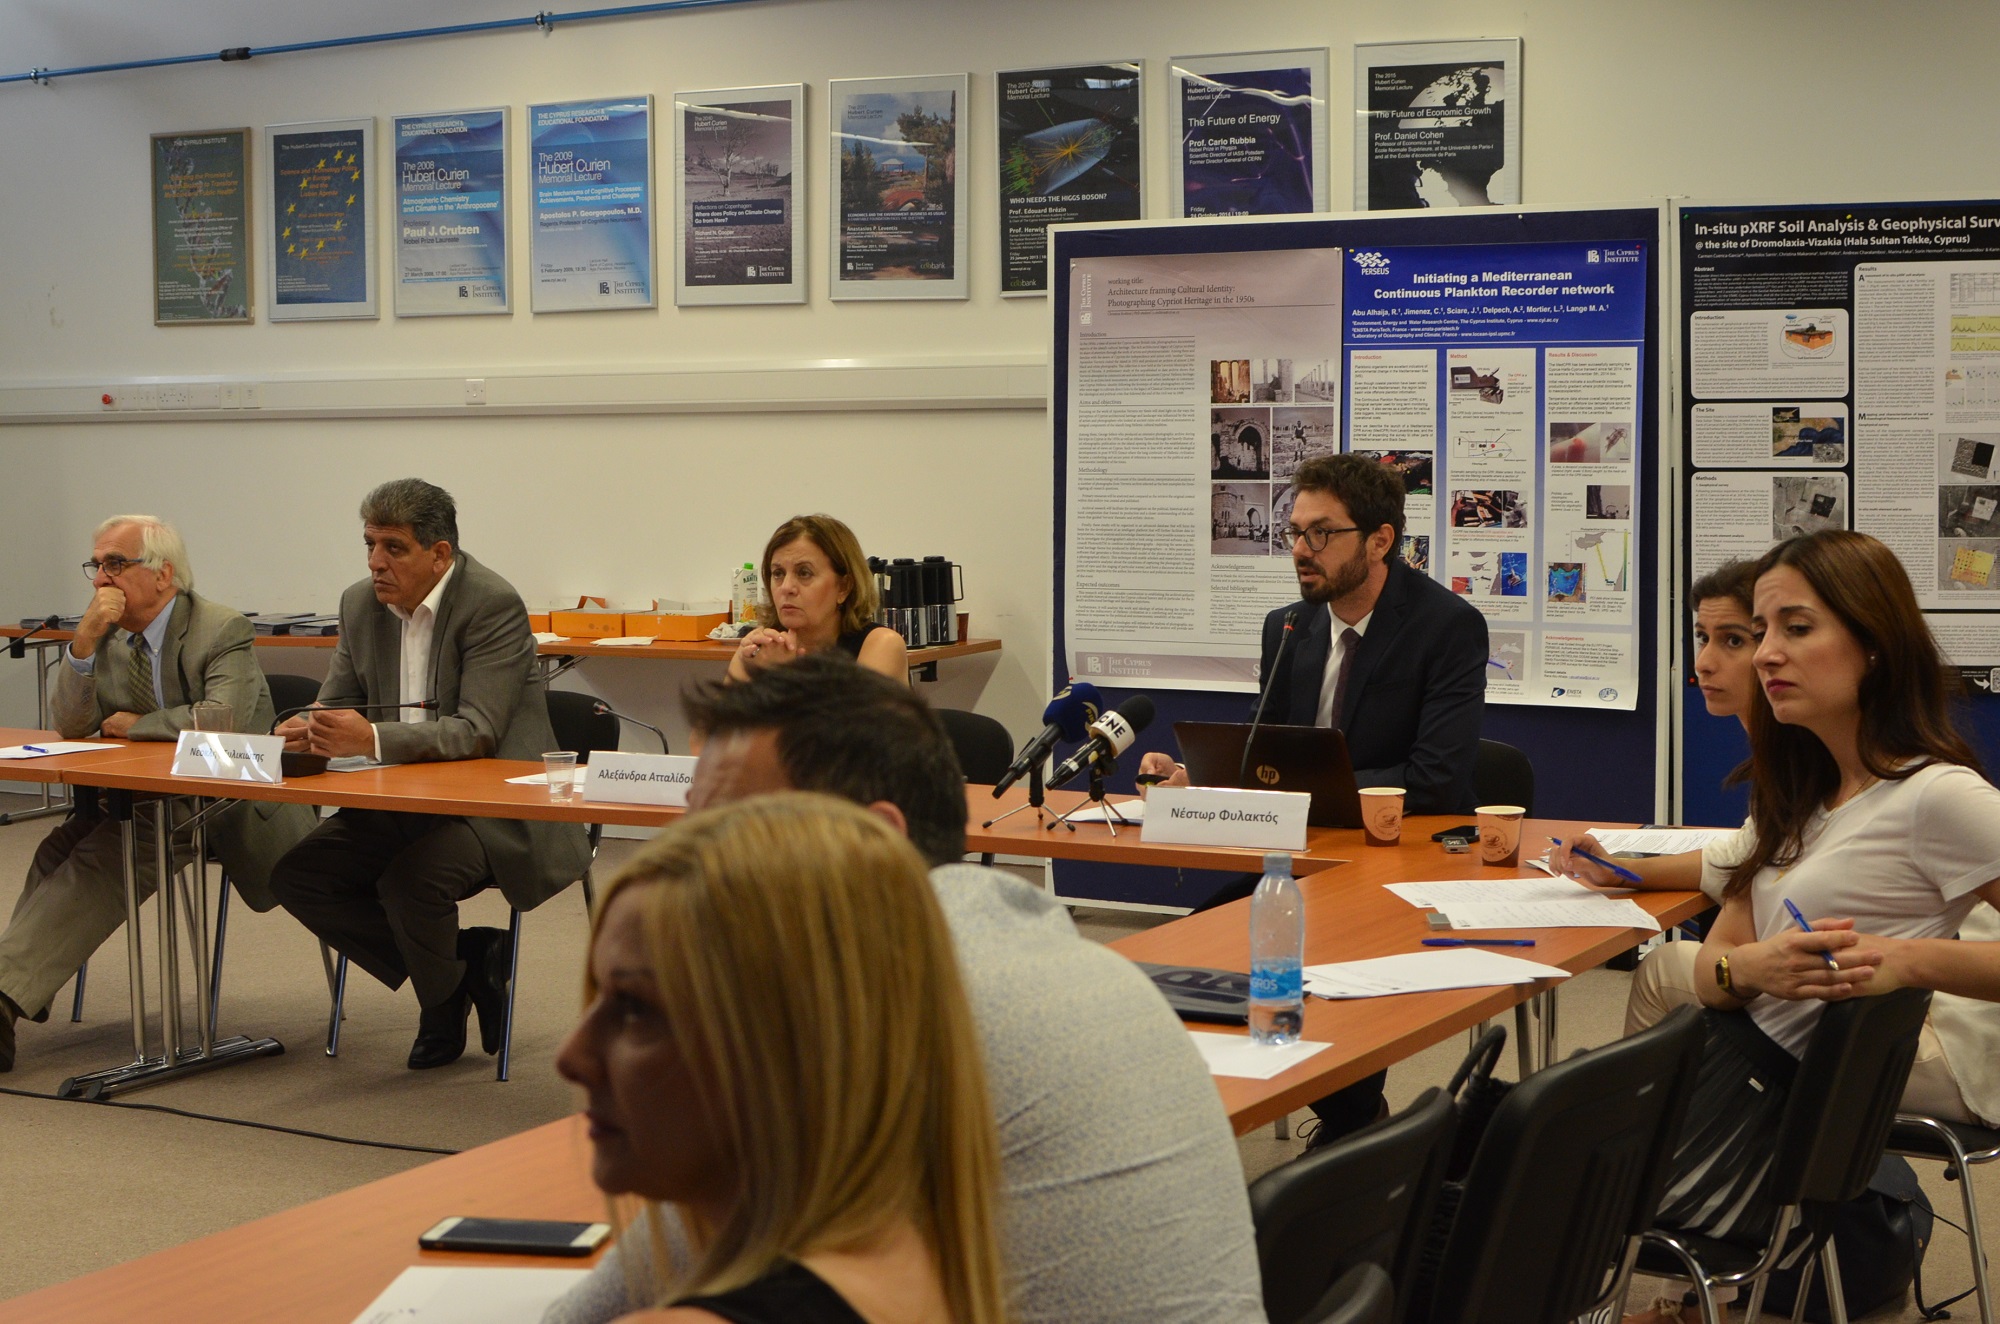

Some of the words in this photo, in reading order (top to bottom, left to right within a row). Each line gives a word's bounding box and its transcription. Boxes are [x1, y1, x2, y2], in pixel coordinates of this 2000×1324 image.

[1375, 111, 1390, 119] The
[1391, 109, 1416, 118] Future
[1417, 109, 1425, 117] of
[1426, 107, 1463, 117] Economic
[1464, 106, 1492, 115] Growth
[1188, 117, 1205, 127] The
[1207, 116, 1236, 126] Future
[1238, 114, 1247, 124] of
[1249, 113, 1281, 124] Energy
[1189, 139, 1207, 147] Prof.
[1208, 138, 1228, 146] Carlo
[1229, 136, 1256, 145] Rubbia
[1375, 132, 1392, 141] Prof.
[1394, 131, 1418, 140] Daniel
[1419, 131, 1444, 139] Cohen
[539, 152, 553, 162] The
[554, 151, 573, 161] 2009
[403, 162, 416, 171] The
[417, 161, 435, 170] 2008
[539, 161, 574, 175] Hubert
[576, 158, 611, 173] Curien
[402, 170, 436, 182] Hubert
[437, 168, 470, 181] Curien
[539, 174, 573, 184] Memorial
[574, 172, 602, 182] Lecture
[403, 182, 434, 192] Memorial
[436, 181, 462, 190] Lecture
[403, 197, 439, 206] Atmospheric
[440, 196, 469, 204] Chemistry
[403, 205, 414, 213] and
[415, 204, 437, 212] Climate
[539, 212, 571, 220] Apostolos
[580, 208, 627, 217] Georgopoulos,
[403, 227, 426, 238] Paul
[428, 226, 438, 237] J.
[439, 225, 480, 235] Crutzen
[1024, 226, 1045, 234] Herwig
[1694, 222, 1737, 235] In-situ
[1740, 221, 1776, 237] pXRF
[1779, 220, 1804, 233] Soil
[1807, 218, 1865, 235] Analysis
[1868, 218, 1879, 231] &
[1881, 216, 1967, 234] Geophysical
[1695, 242, 1704, 250] @
[1705, 241, 1720, 249] the
[1721, 240, 1739, 249] site
[1740, 239, 1750, 248] of
[1751, 237, 1842, 248] Dromolaxia-Vizakia
[1843, 236, 1868, 248] (Hala
[1870, 236, 1901, 245] Sultan
[1901, 235, 1932, 245] Tekke,
[1933, 234, 1971, 245] Cyprus)
[1361, 267, 1390, 275] PERSEUS
[1108, 278, 1131, 286] working
[1413, 273, 1468, 285] Initiating
[1482, 271, 1573, 283] Mediterranean
[1107, 286, 1148, 296] Architecture
[1150, 286, 1176, 296] framing
[1177, 285, 1205, 294] Cultural
[1206, 284, 1235, 294] Identity:
[1374, 288, 1441, 299] Continuous
[1444, 287, 1498, 298] Plankton
[1501, 285, 1559, 296] Recorder
[1562, 284, 1615, 295] network
[1107, 298, 1156, 308] Photographing
[1157, 297, 1183, 306] Cypriot
[1184, 297, 1212, 306] Heritage
[1214, 296, 1221, 304] in
[1235, 295, 1255, 303] 1950s
[1366, 308, 1390, 317] Alhaija,
[1404, 308, 1432, 316] Jimenez,
[1446, 307, 1470, 315] Sciare,
[1482, 306, 1512, 315] Delpech,
[1526, 305, 1553, 314] Mortier,
[1566, 305, 1588, 314] Lange
[1108, 666, 1151, 676] INSTITUTE
[1098, 714, 1126, 739] ONE
[598, 769, 647, 782] Αλεξάνδρα
[1260, 765, 1276, 784] hp
[1170, 806, 1216, 823] Νέστωρ
[1218, 809, 1279, 825] Φυλακτός
